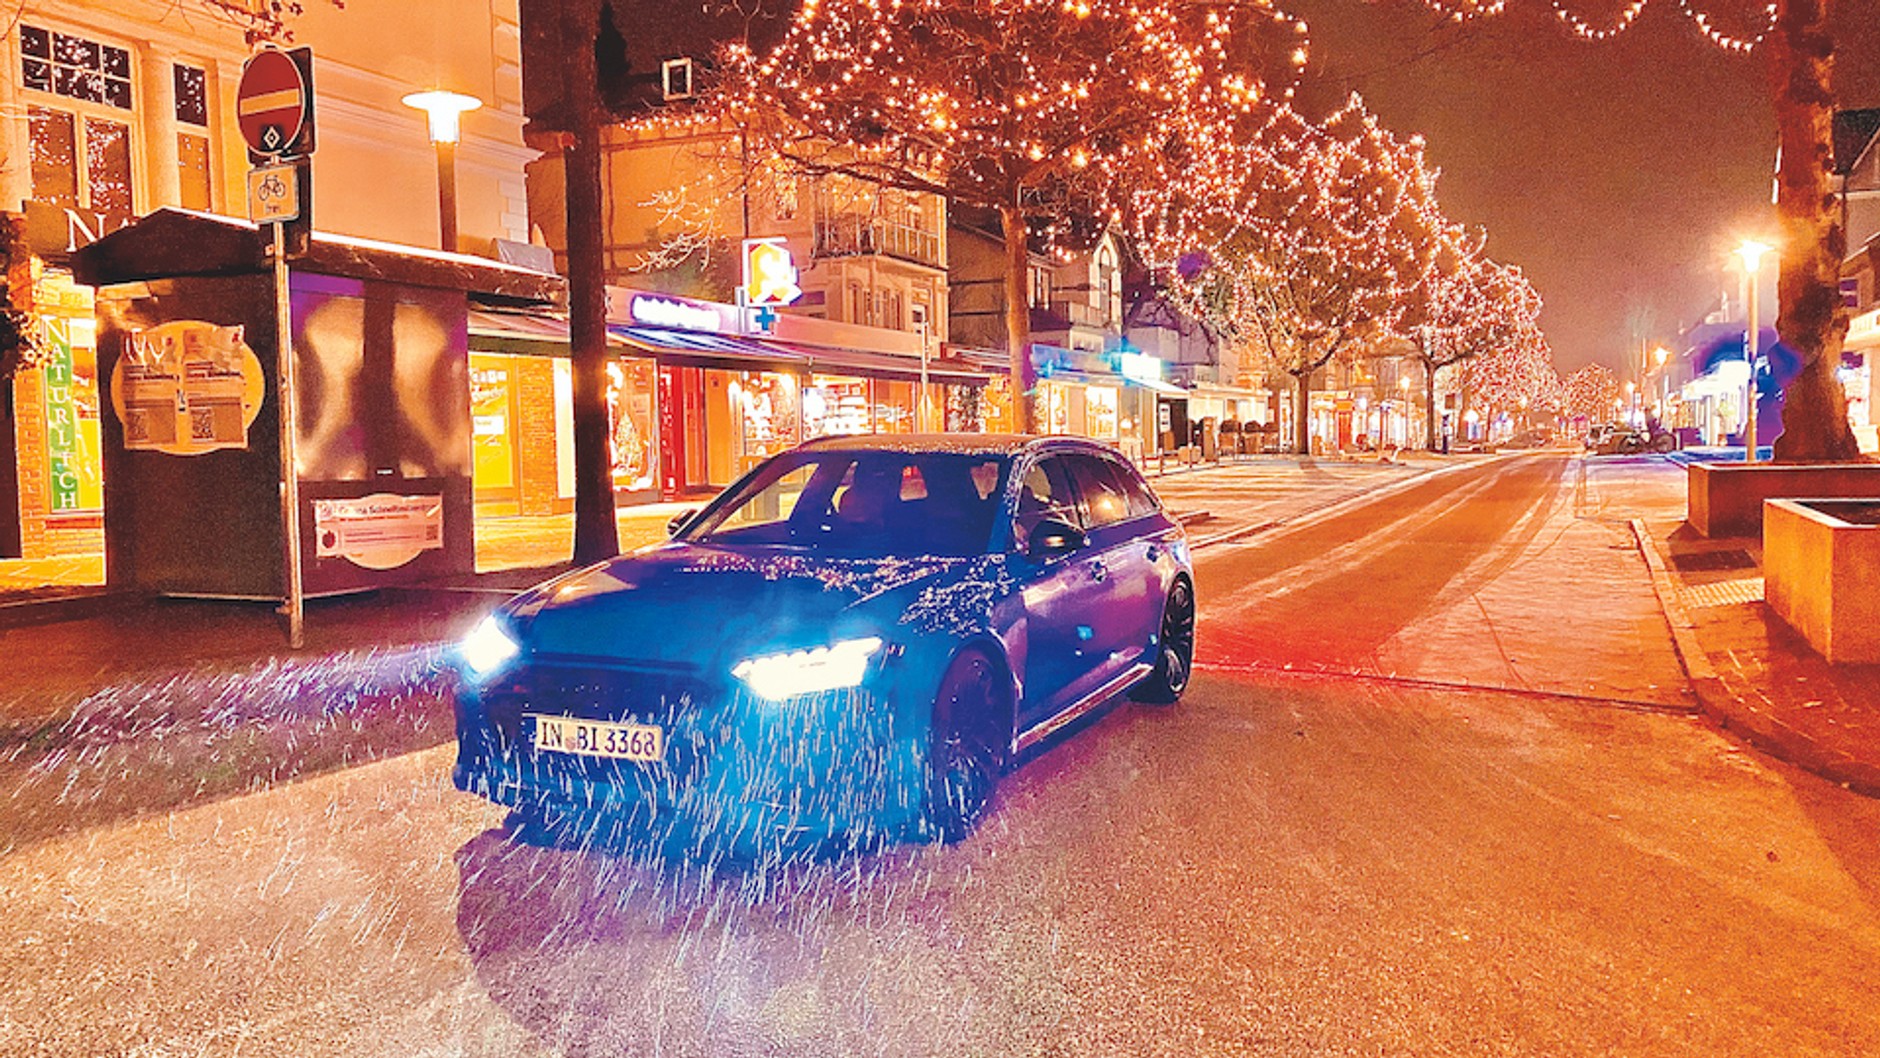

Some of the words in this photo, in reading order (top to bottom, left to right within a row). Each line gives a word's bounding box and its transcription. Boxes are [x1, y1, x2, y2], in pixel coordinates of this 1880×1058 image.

[541, 721, 562, 747] IN
[577, 726, 599, 751] BI
[604, 728, 655, 757] 3368
